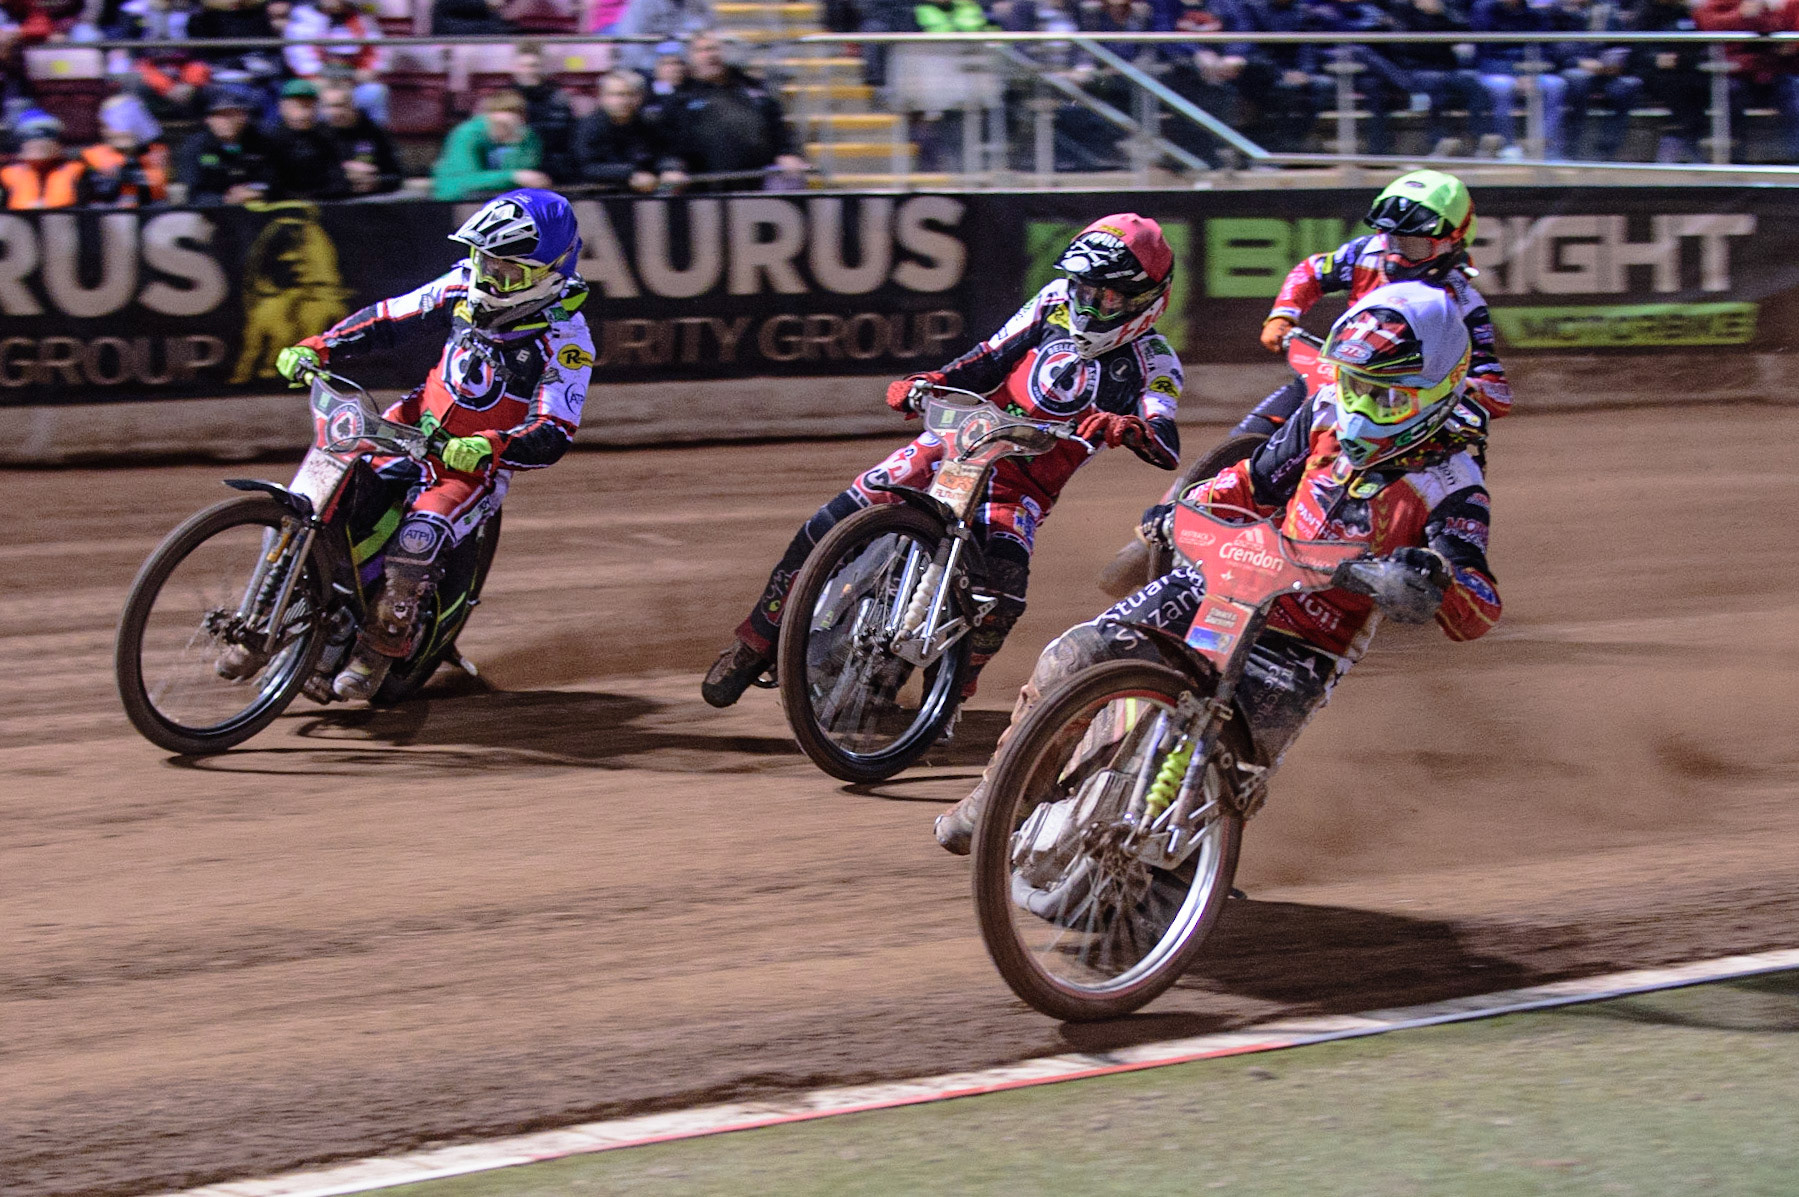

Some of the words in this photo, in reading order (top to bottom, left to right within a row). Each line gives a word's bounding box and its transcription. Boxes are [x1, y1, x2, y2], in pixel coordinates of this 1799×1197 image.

[404, 528, 432, 542] ATPI
[1219, 541, 1285, 572] Crendon
[1102, 565, 1187, 621] Stuart
